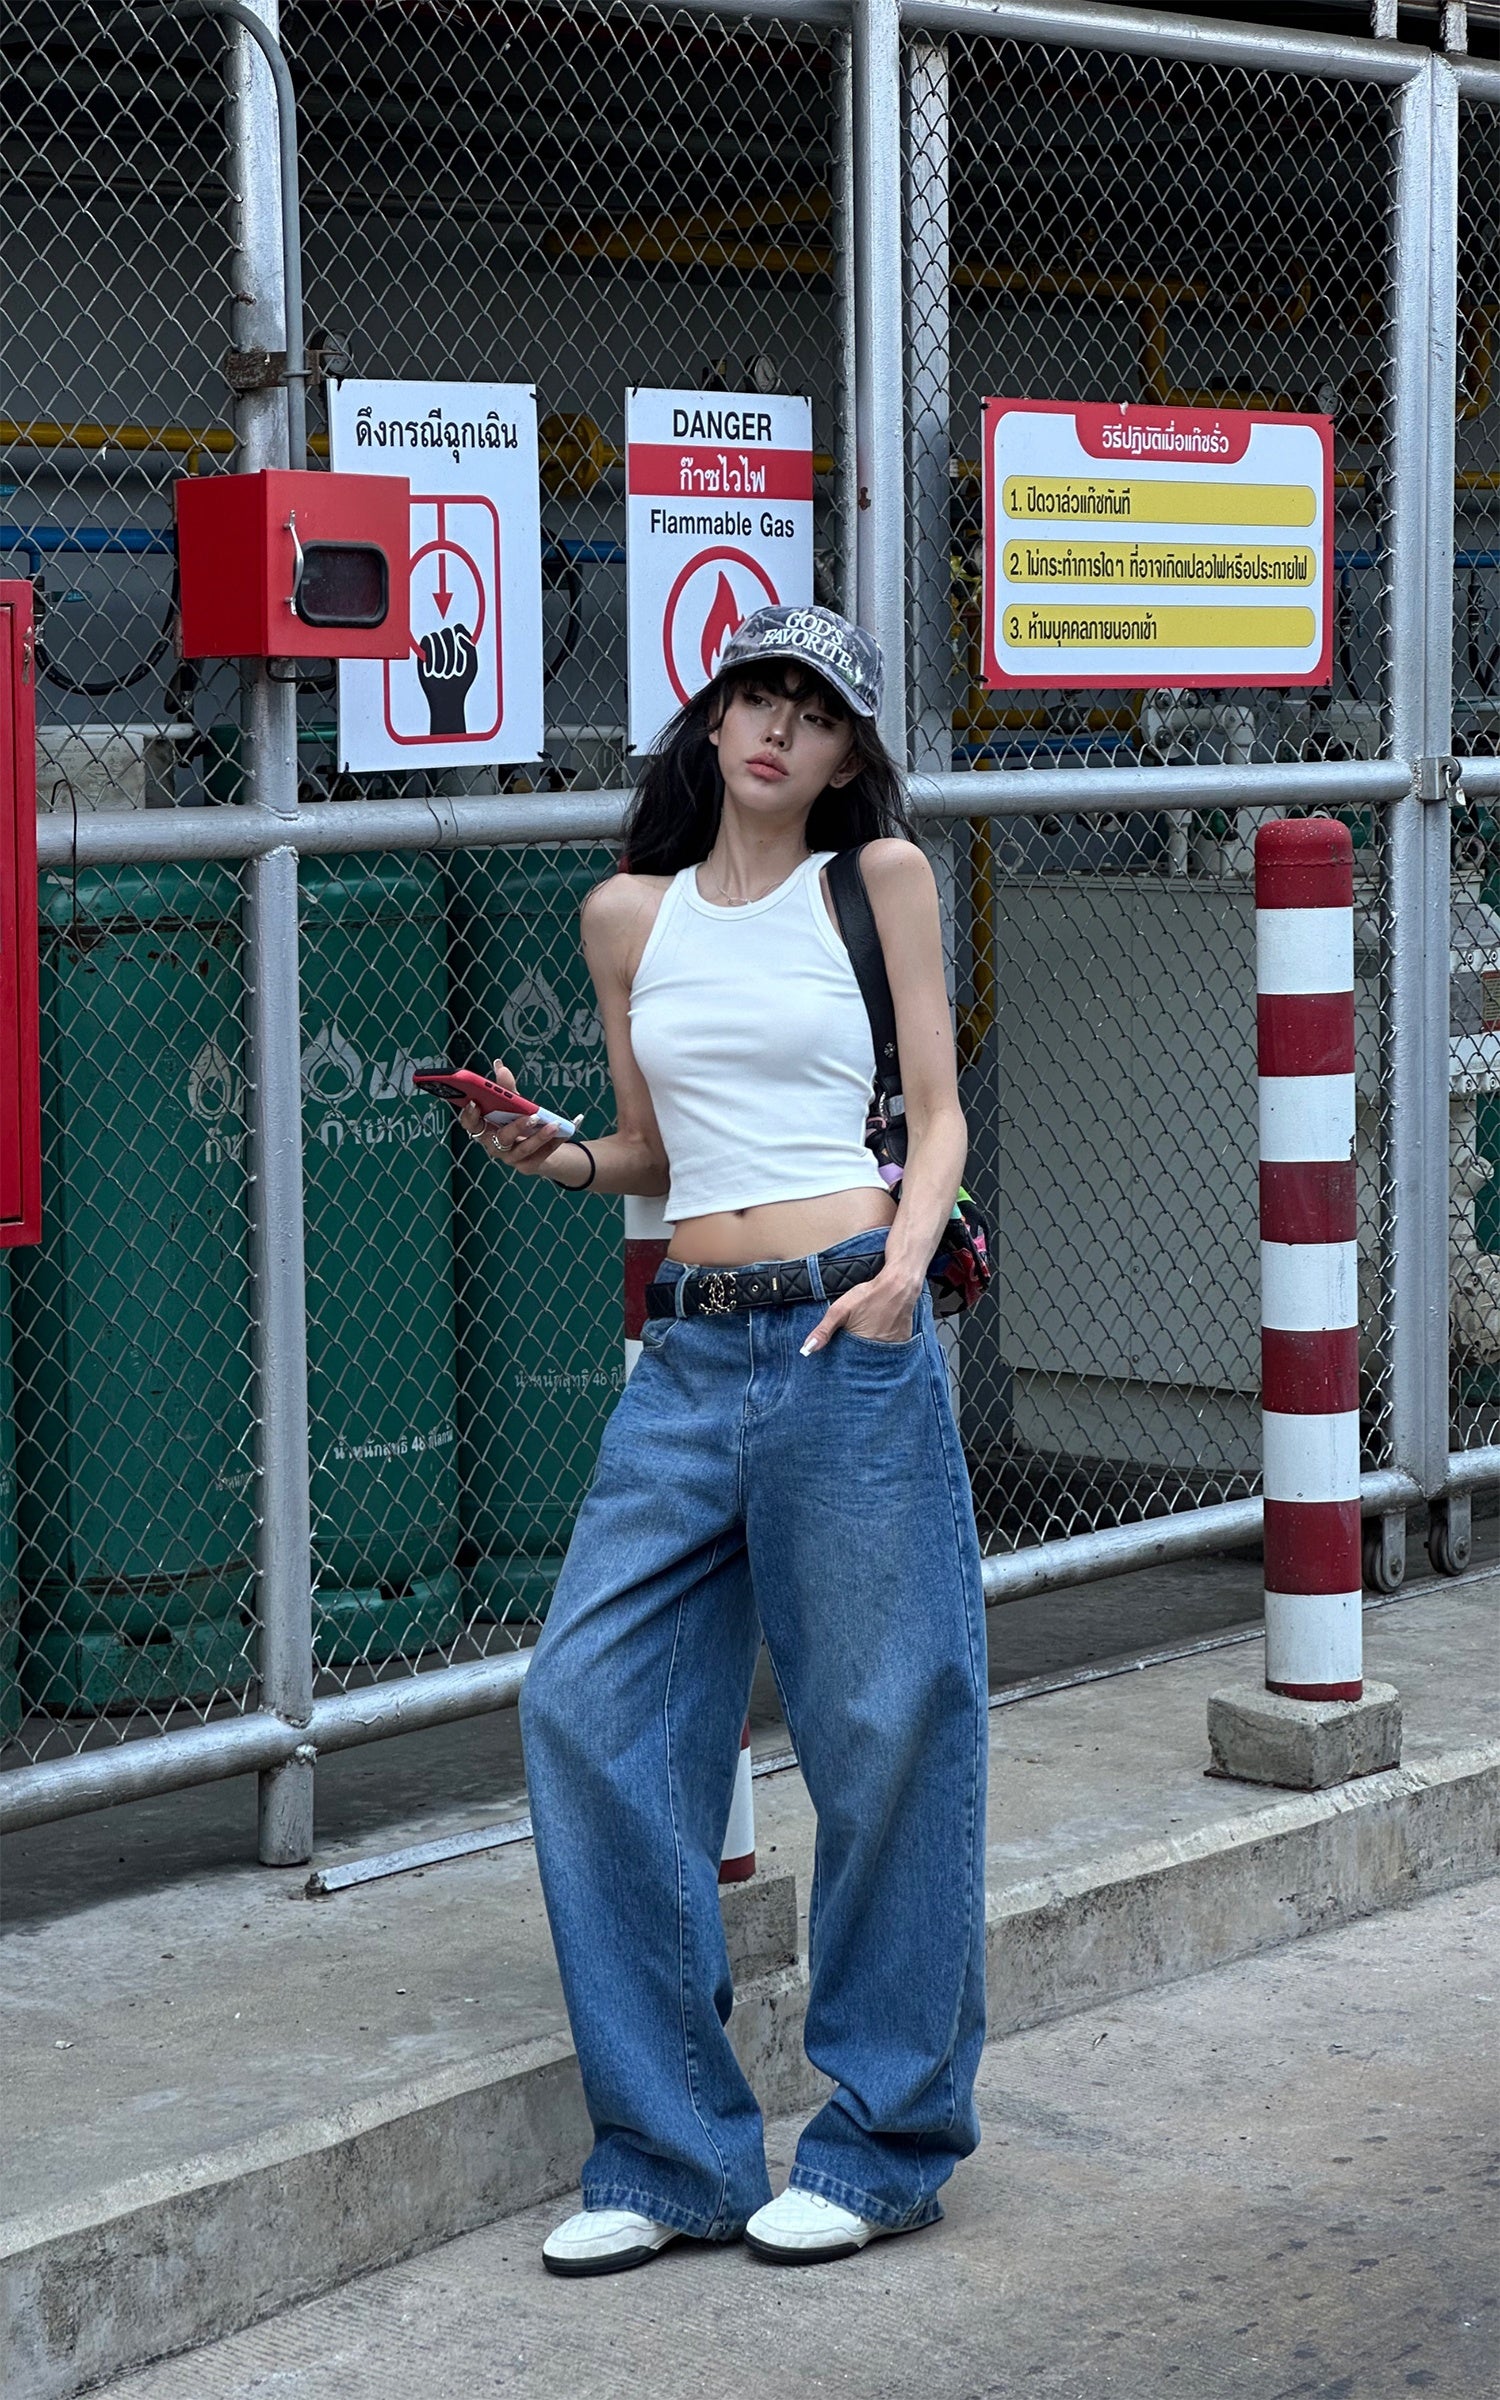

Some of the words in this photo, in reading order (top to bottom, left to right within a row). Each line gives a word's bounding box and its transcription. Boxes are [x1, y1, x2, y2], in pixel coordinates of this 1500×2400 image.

[355, 406, 518, 464] ดึงกรณีฉุกเฉิน
[673, 408, 772, 441] DANGER
[679, 453, 766, 493] ก๊าซไวไฟ
[1010, 488, 1022, 511] 1.
[651, 509, 752, 537] Flammable
[760, 512, 794, 538] Gas
[1010, 552, 1022, 576] 2.
[785, 609, 845, 646] GOD'S
[1010, 616, 1022, 639] 3.
[1028, 611, 1157, 647] ห้ามบุคคลภายนอกเข้า
[759, 628, 853, 671] FAVORITE
